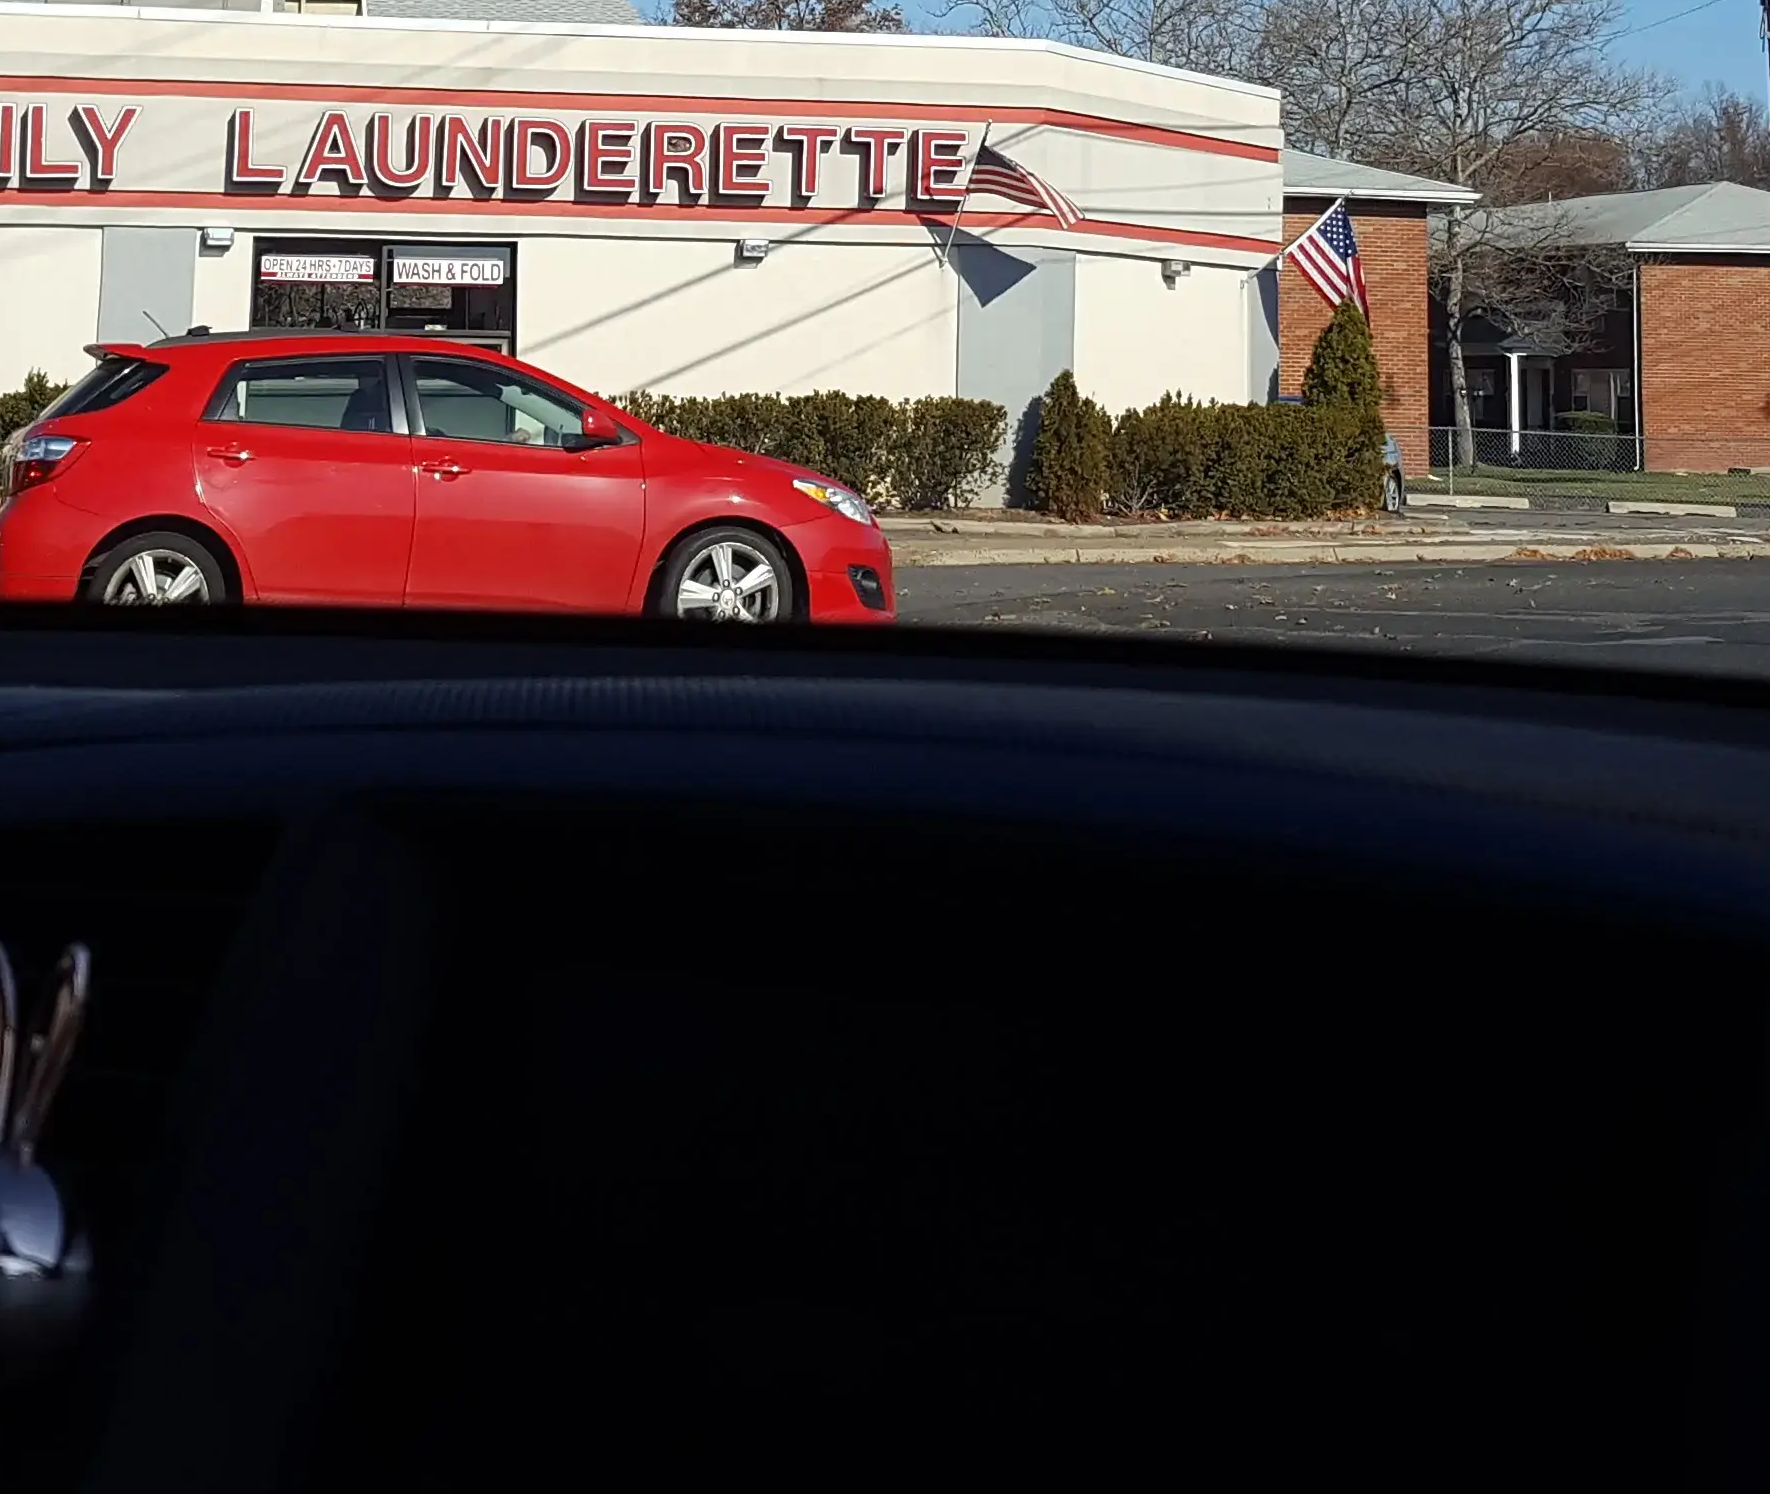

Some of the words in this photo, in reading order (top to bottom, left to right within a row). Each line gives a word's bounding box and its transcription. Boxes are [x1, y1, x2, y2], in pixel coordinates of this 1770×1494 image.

[232, 106, 970, 202] LAUNDERETTE
[263, 258, 293, 271] OPEN
[295, 258, 307, 272] 24
[309, 259, 332, 273] HRS
[337, 259, 343, 273] 7
[344, 259, 372, 273] DAYS
[396, 261, 442, 280] WASH
[446, 262, 456, 281] &
[460, 263, 501, 282] FOLD
